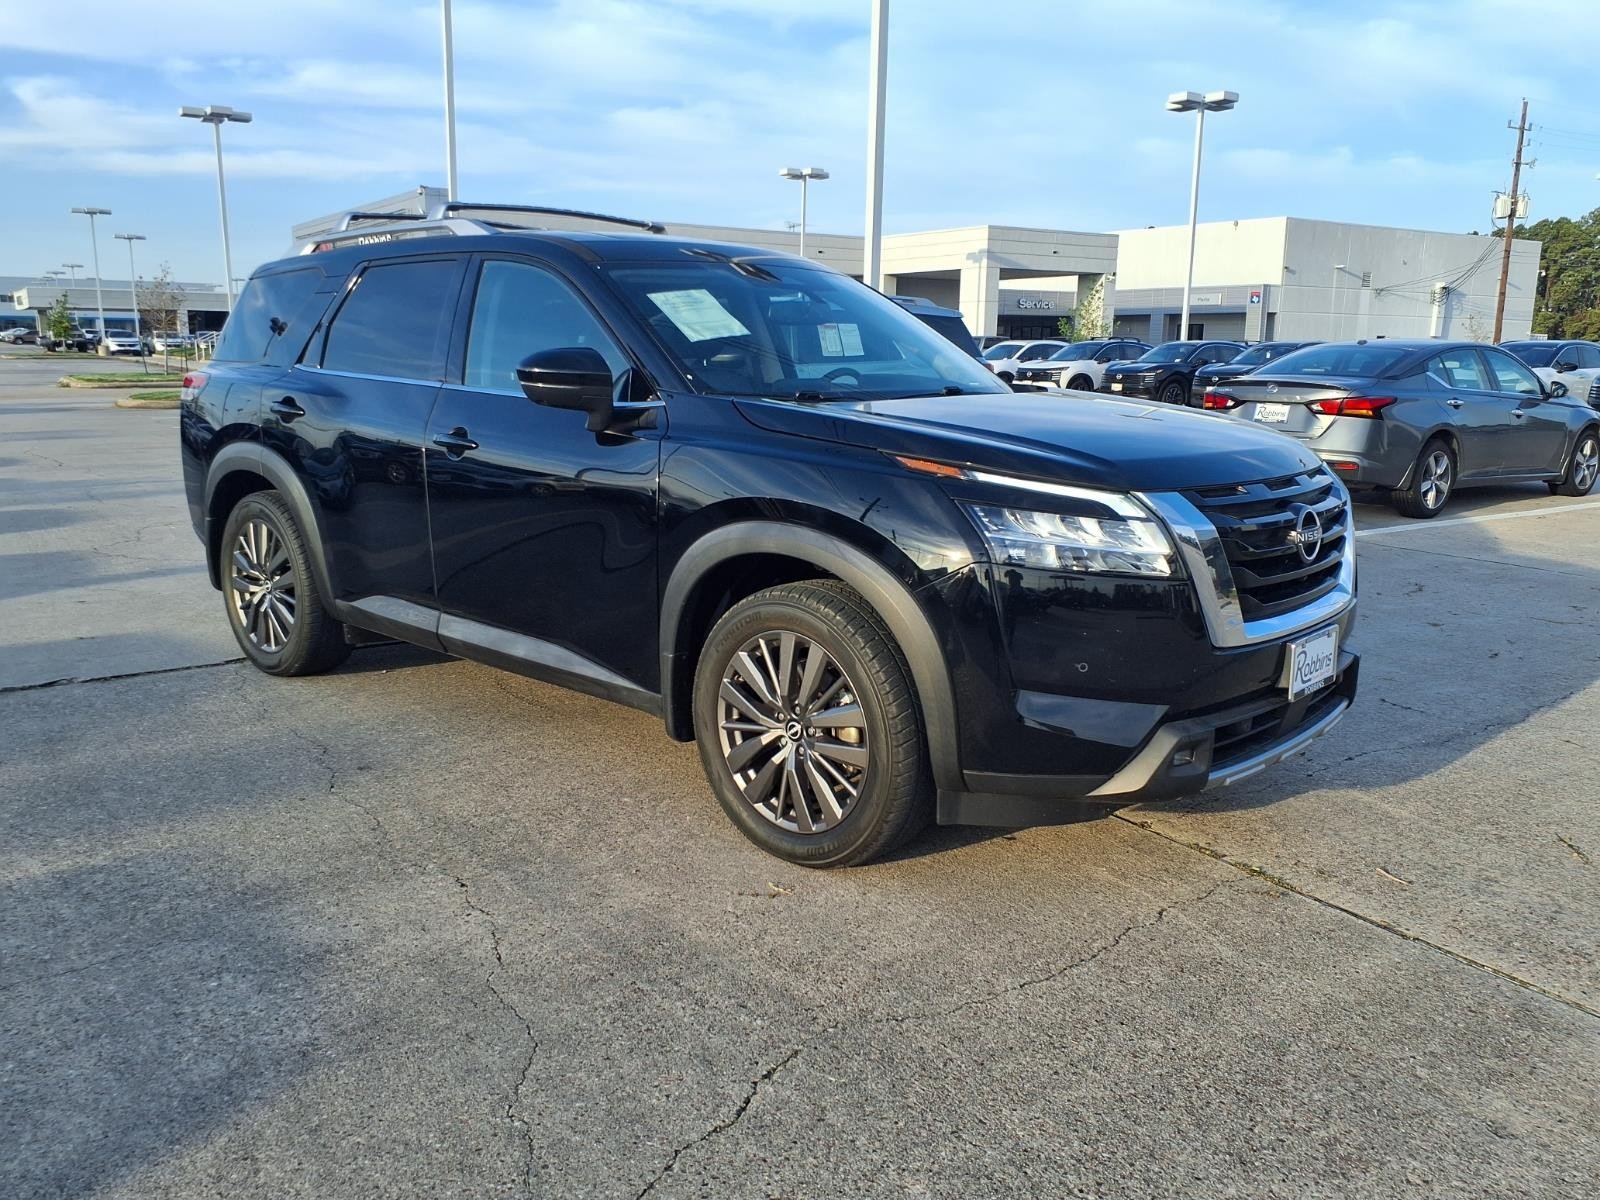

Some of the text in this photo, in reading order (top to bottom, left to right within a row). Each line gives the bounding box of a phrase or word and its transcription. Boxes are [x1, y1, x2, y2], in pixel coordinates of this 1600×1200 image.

[1018, 298, 1055, 309] Service
[1257, 406, 1287, 419] Robbins
[1297, 530, 1320, 542] NISS
[1295, 650, 1333, 685] Robbins
